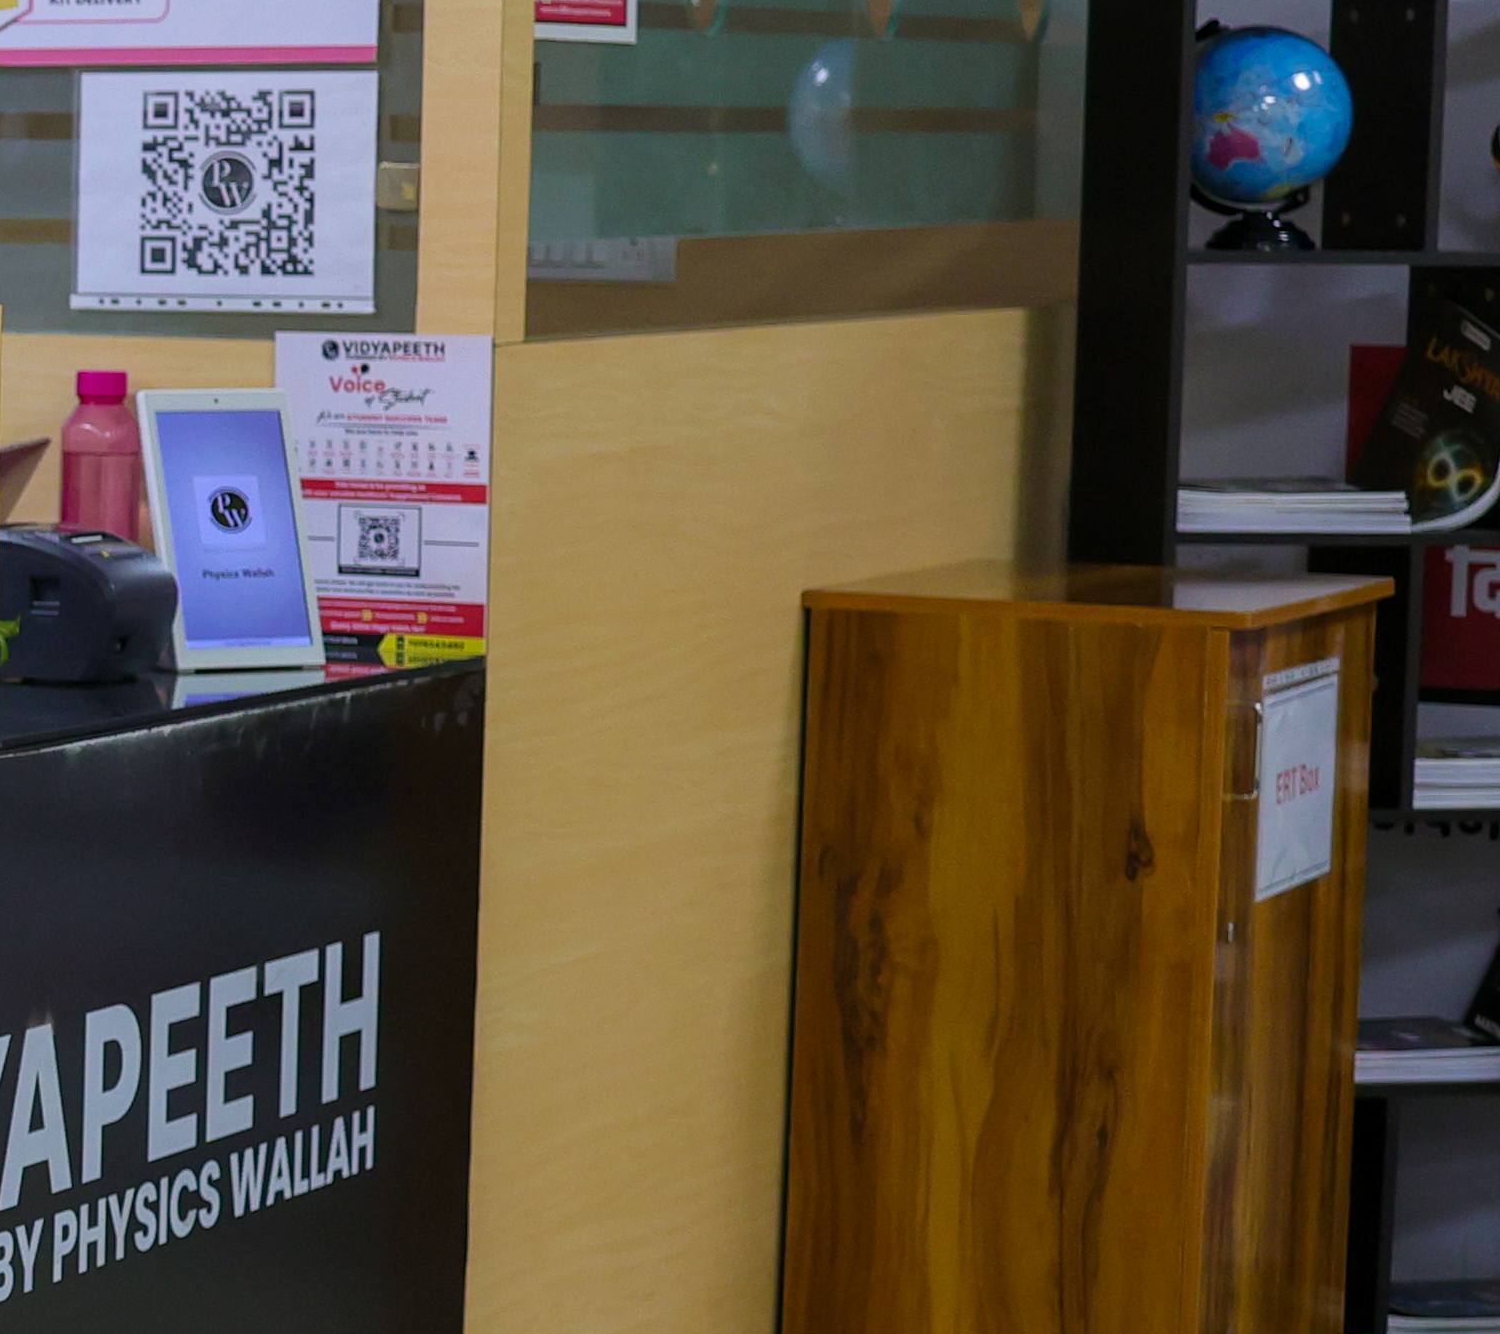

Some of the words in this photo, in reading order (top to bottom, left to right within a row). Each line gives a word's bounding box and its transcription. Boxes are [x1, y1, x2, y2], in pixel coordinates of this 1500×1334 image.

[342, 342, 445, 356] VIDYAPEETH
[52, 1171, 221, 1285] PHYSICS
[229, 1105, 376, 1218] WALLAH
